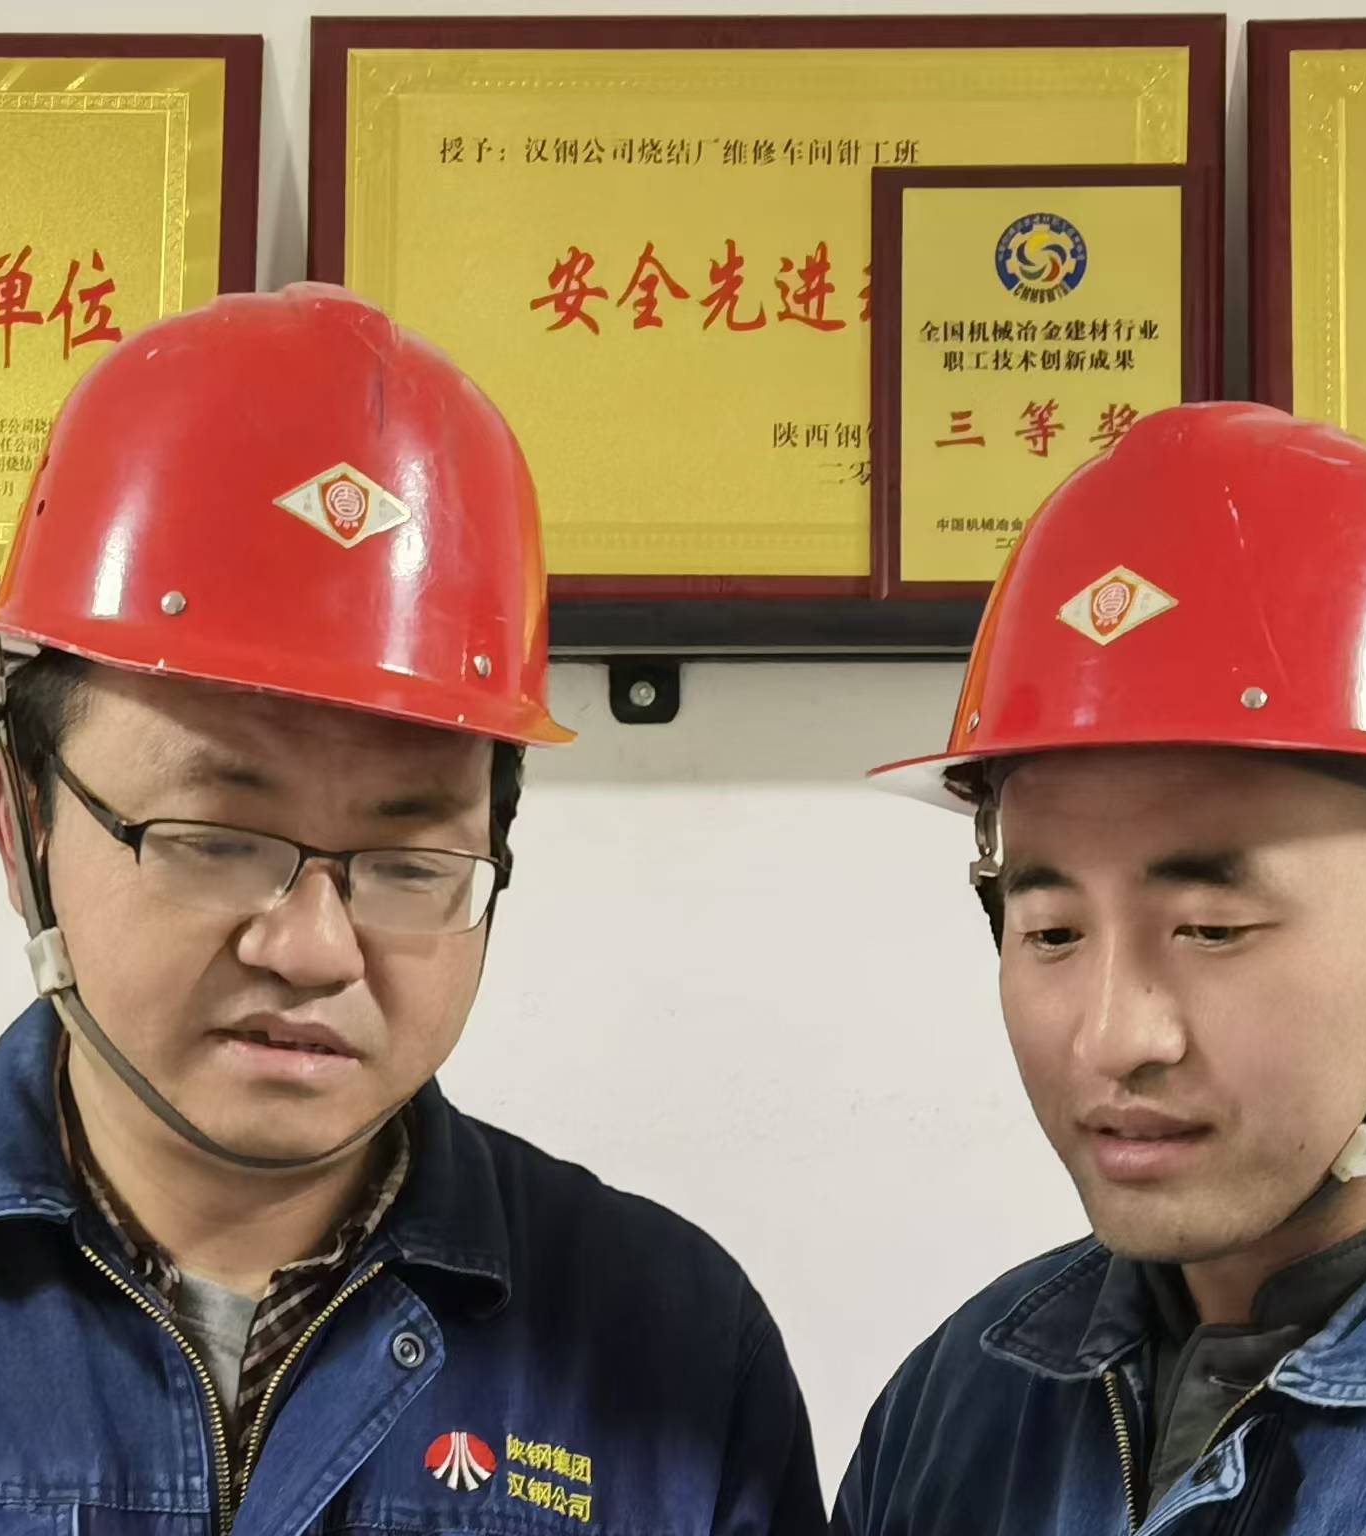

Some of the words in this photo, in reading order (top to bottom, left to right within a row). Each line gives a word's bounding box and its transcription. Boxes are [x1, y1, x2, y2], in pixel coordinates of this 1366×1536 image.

[438, 135, 921, 167] 授予：汉钢公司烧结厂维修车间钳工班
[530, 239, 871, 335] 安全先进
[919, 318, 1159, 343] 全国机械冶金建材行业
[942, 349, 1135, 373] 职工技术创新成果
[772, 420, 871, 449] 陕西钢
[934, 399, 1139, 458] 三等奖
[506, 1433, 592, 1485] 陕钢集团
[507, 1471, 592, 1523] 汉钢公司
